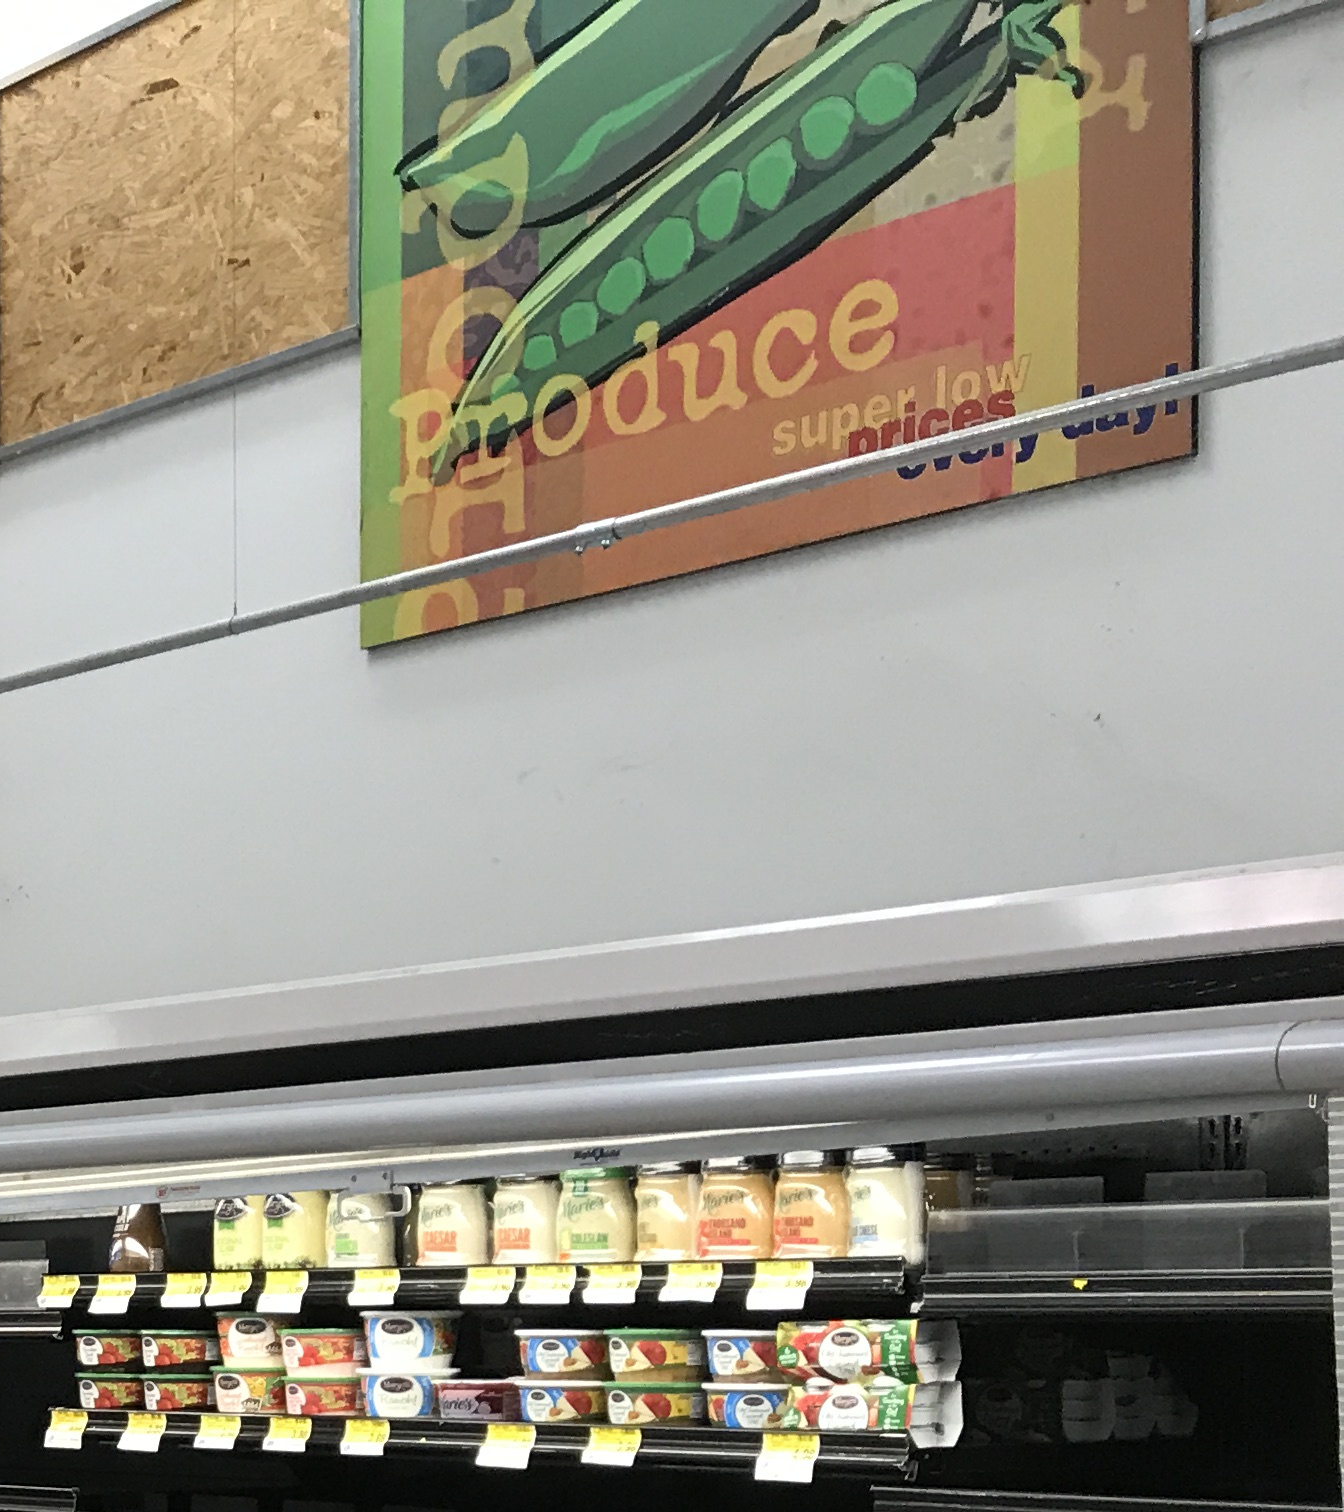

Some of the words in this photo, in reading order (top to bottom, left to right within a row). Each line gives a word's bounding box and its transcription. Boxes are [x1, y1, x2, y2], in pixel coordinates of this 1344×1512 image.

[389, 279, 900, 500] Produce
[771, 384, 916, 457] super
[935, 353, 1033, 407] low
[847, 389, 1018, 457] prices
